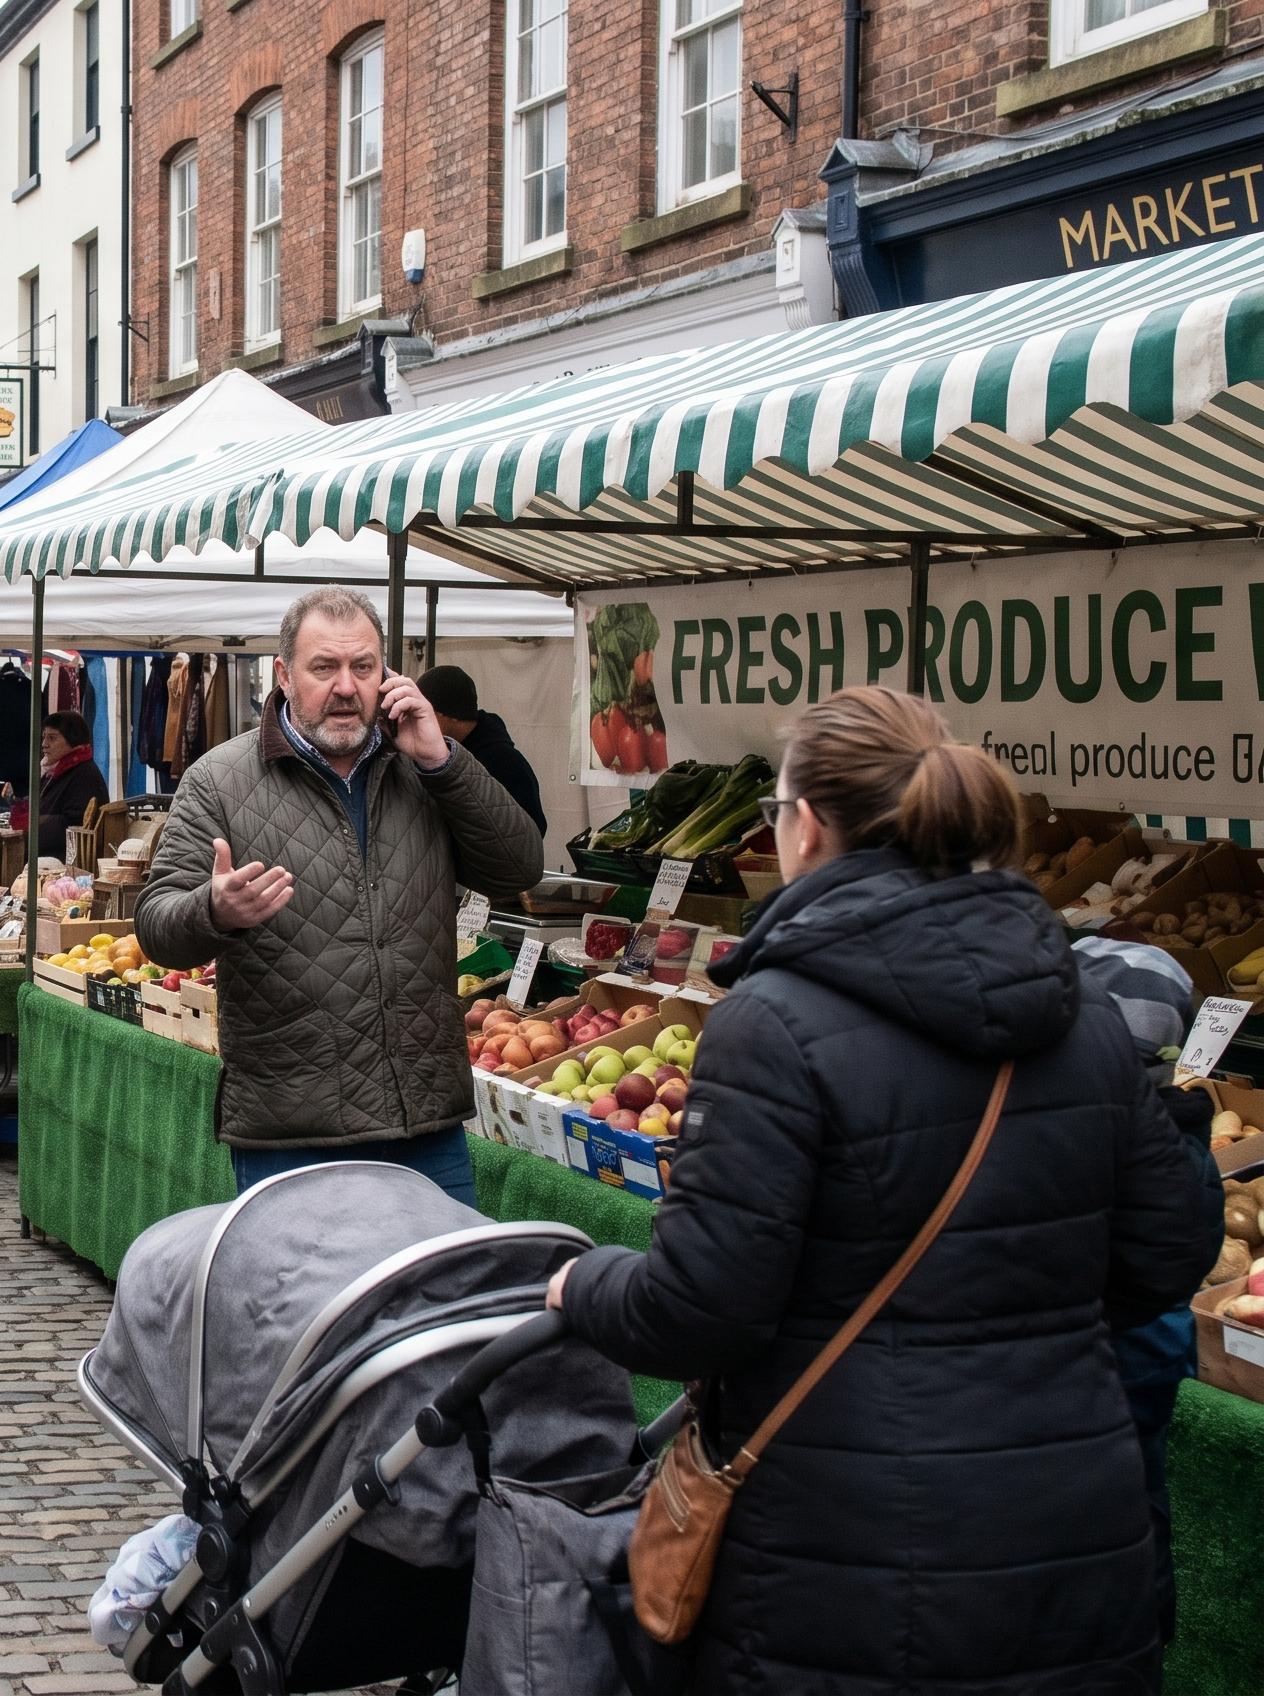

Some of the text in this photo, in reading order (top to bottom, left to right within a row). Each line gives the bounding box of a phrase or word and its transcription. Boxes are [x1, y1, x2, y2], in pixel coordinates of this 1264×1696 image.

[1058, 163, 1263, 269] MARKET
[671, 611, 845, 706] FRESH
[863, 585, 1224, 705] PRODUCE
[1069, 731, 1216, 788] produce
